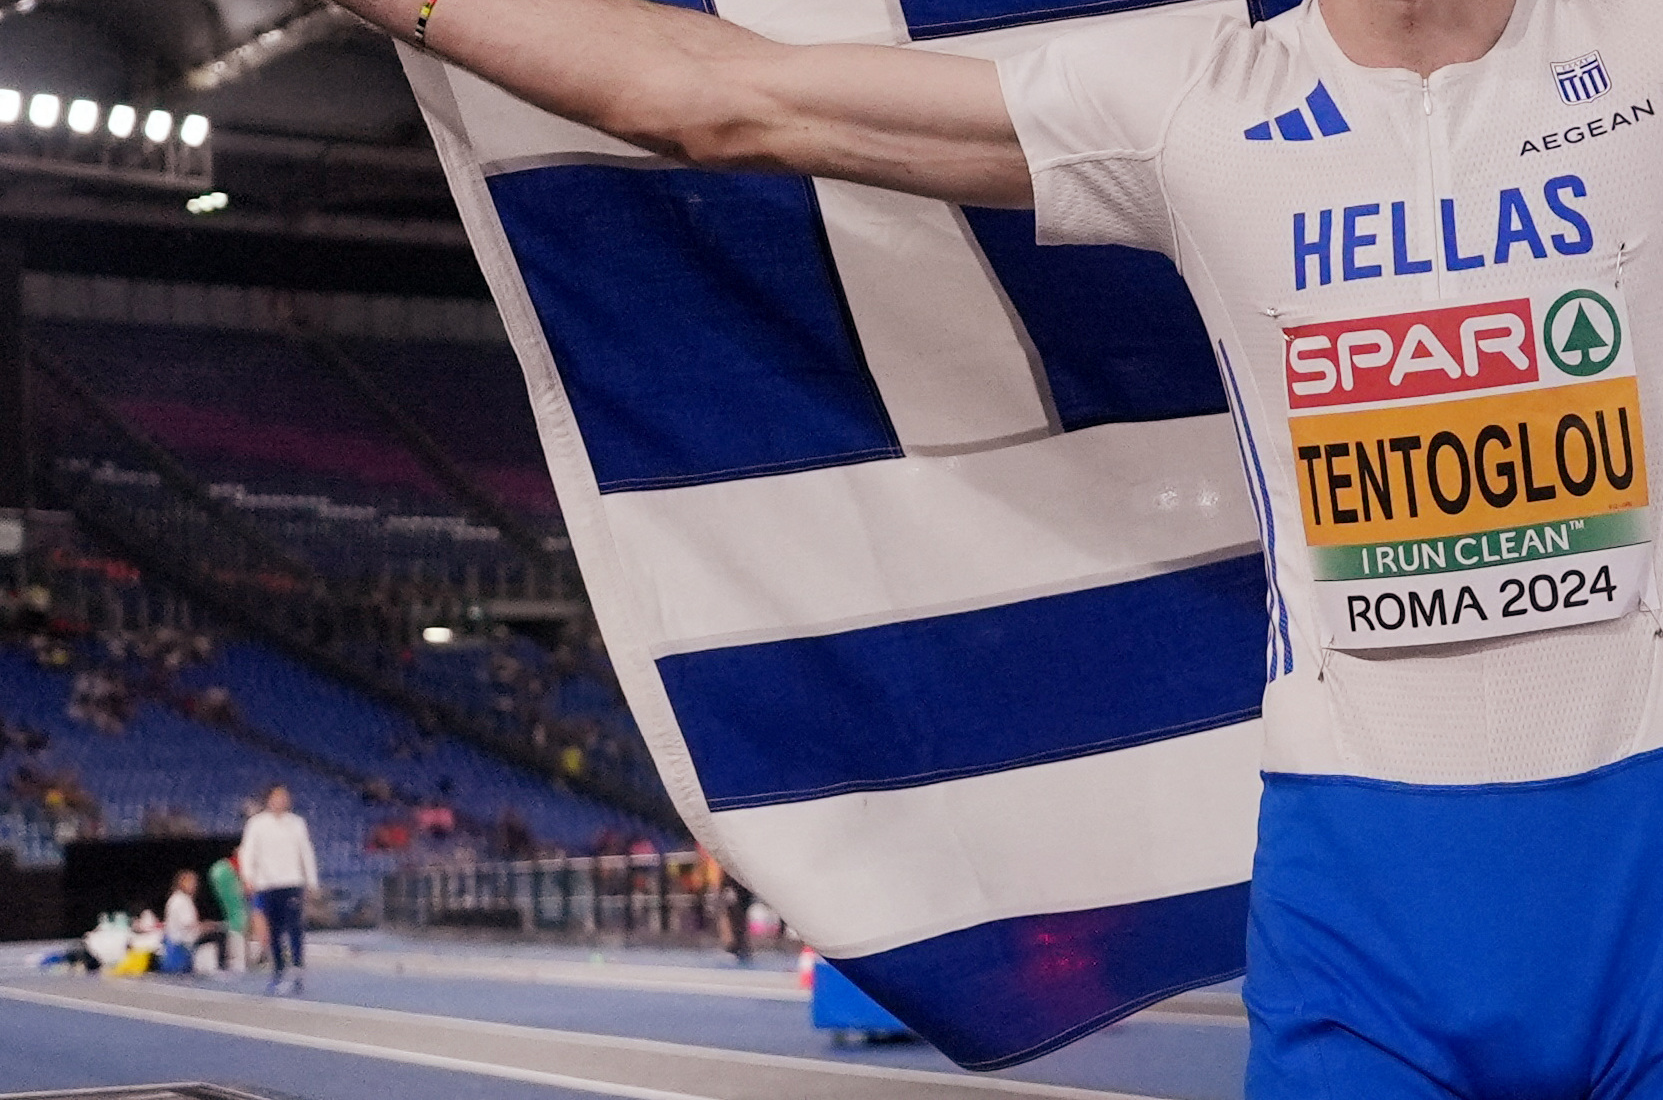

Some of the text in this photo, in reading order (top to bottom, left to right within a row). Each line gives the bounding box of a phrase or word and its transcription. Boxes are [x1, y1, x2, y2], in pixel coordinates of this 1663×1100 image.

[1520, 99, 1655, 157] AEGEAN
[1293, 174, 1594, 291] HELLAS
[1289, 312, 1530, 396] SPAR
[1298, 407, 1634, 526] TENTOGLOU
[1361, 548, 1370, 575] I
[1376, 541, 1447, 574] RUN
[1347, 565, 1617, 632] ROMA 2024
